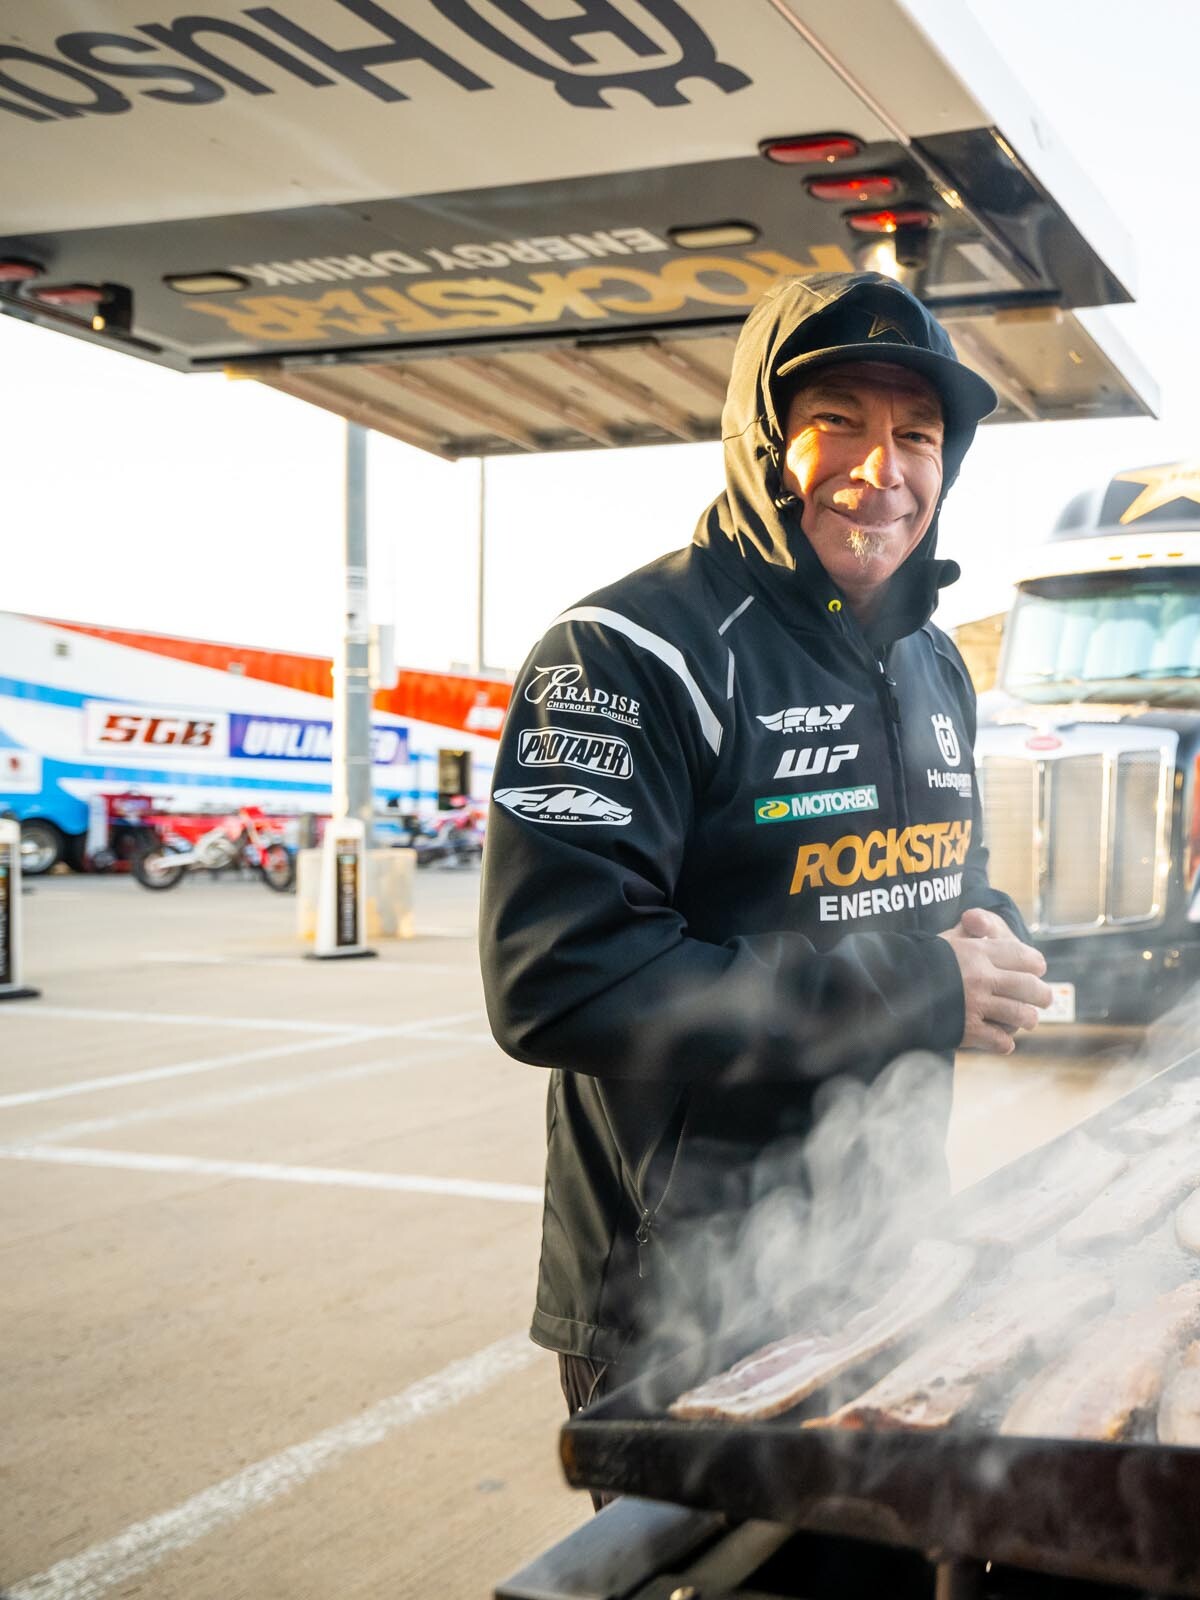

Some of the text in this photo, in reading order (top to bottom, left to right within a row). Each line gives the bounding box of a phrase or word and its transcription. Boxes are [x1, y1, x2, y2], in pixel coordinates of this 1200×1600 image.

[0, 0, 497, 123] Husq
[230, 227, 670, 287] ENERGY DRINK
[524, 664, 641, 717] PARADISE
[546, 700, 597, 712] CHEVROLET
[782, 723, 841, 734] RACING
[784, 703, 855, 728] FLY
[773, 743, 860, 779] WP
[496, 789, 633, 820] FMF
[791, 788, 875, 817] MOTOREX
[820, 881, 918, 922] ENERGY
